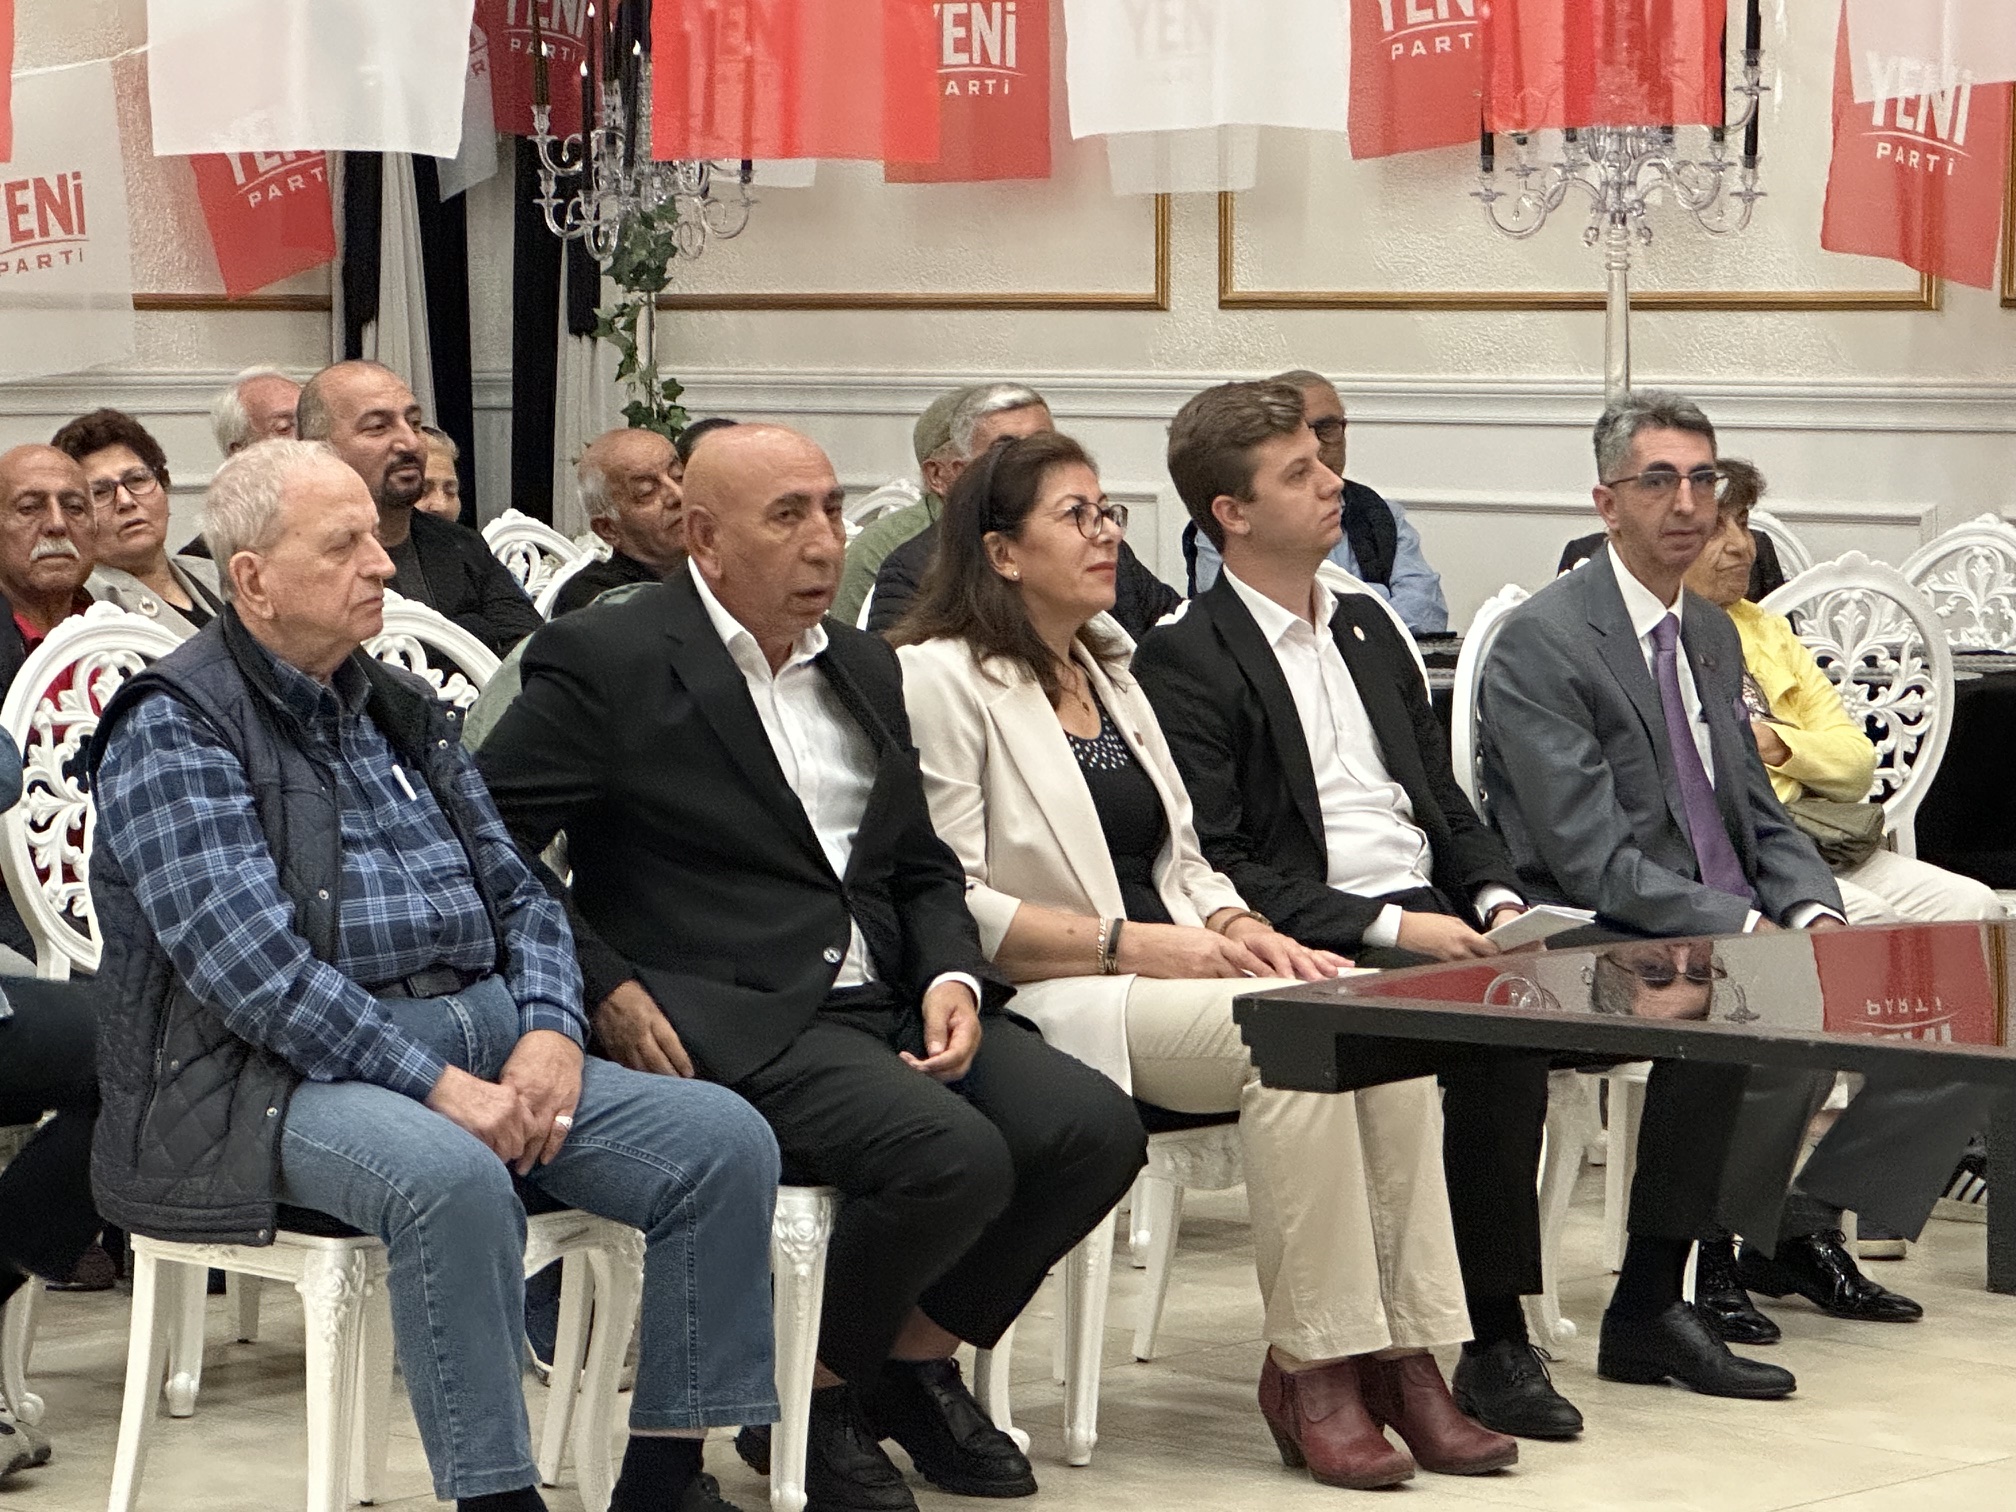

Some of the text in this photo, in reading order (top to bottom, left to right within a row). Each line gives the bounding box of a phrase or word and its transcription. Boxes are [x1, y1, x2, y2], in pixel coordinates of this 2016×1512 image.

[933, 2, 1016, 68] ENi
[1391, 32, 1474, 60] PART
[945, 79, 1009, 95] ARTi
[0, 171, 85, 243] ENi
[248, 167, 323, 208] PART
